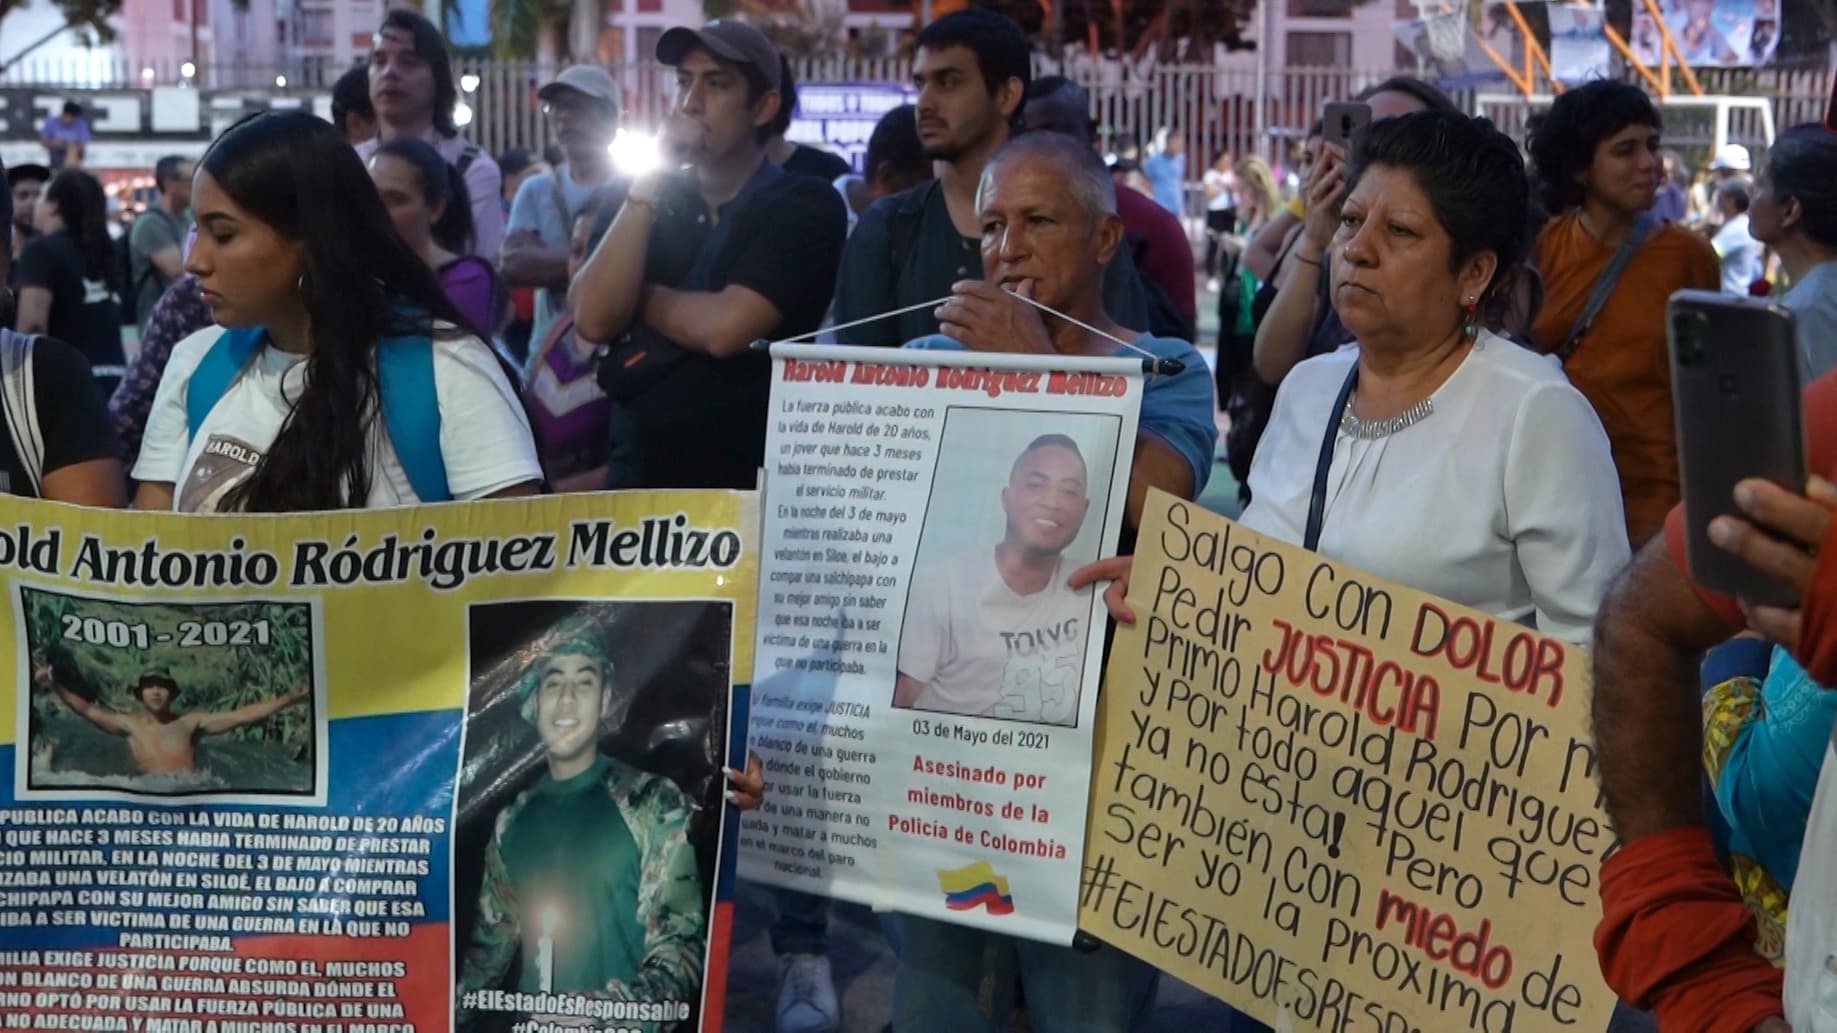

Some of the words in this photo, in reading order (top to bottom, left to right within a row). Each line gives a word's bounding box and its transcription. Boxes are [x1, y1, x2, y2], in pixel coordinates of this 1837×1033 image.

[783, 358, 847, 383] Harold
[851, 361, 929, 388] Antonio
[1046, 371, 1127, 397] Mellizo
[875, 405, 911, 418] acabo
[913, 408, 934, 419] con
[884, 424, 898, 437] 20
[820, 446, 840, 457] que
[843, 443, 870, 456] hace
[885, 447, 922, 460] meses
[803, 463, 857, 478] terminado
[876, 468, 919, 482] prestar
[806, 486, 846, 498] servicio
[875, 510, 907, 526] mayo
[70, 537, 278, 587] Antonio
[290, 528, 555, 589] Ródriguez
[567, 515, 741, 568] Mellizo
[876, 575, 896, 587] con
[1161, 502, 1284, 607] Salgo
[1305, 563, 1393, 640] Con
[1410, 602, 1565, 708] DOLOR
[61, 615, 148, 648] 2001
[180, 620, 271, 647] 2021
[1153, 566, 1251, 653] Pedir
[1262, 617, 1440, 741] JUSTICIA
[1459, 691, 1549, 777] Por
[1145, 616, 1241, 699] Primo
[1251, 664, 1395, 774] Harold
[824, 702, 870, 719] JUSTICIA
[821, 724, 864, 741] muchos
[913, 720, 929, 735] 03
[934, 722, 950, 738] de
[954, 724, 988, 746] Mayo
[992, 728, 1013, 746] del
[1017, 732, 1050, 749] 2021
[836, 748, 876, 764] guerra
[818, 768, 871, 785] gobierno
[913, 755, 1006, 785] Asesinado
[1013, 773, 1047, 790] por
[823, 784, 861, 804] fuerza
[1140, 666, 1161, 707] y
[1167, 679, 1228, 733] Por
[1236, 704, 1317, 782] todo
[1332, 766, 1464, 852] aquel
[1487, 837, 1591, 906] que
[806, 807, 852, 823] manera
[908, 786, 994, 816] miembros
[1001, 801, 1024, 820] de
[1032, 803, 1049, 823] la
[0, 809, 78, 825] PUBLICA
[81, 809, 144, 825] ACABO
[148, 812, 185, 827] CON
[189, 812, 209, 827] LA
[214, 812, 254, 828] VIDA
[258, 813, 280, 829] DE
[283, 815, 350, 831] HAROLD
[353, 816, 374, 832] DE
[376, 817, 398, 833] 20
[400, 815, 445, 833] AÑOS
[1186, 737, 1231, 785] no
[1240, 762, 1346, 859] esta!
[1386, 830, 1483, 909] Pero
[6, 830, 41, 847] QUE
[46, 830, 93, 845] HACE
[97, 830, 109, 845] 3
[114, 830, 173, 846] MESES
[177, 832, 230, 848] HABIA
[235, 834, 332, 852] TERMINADO
[335, 837, 357, 852] DE
[360, 837, 430, 854] PRESTAR
[831, 832, 877, 848] muchos
[954, 826, 974, 844] de
[980, 830, 1066, 860] Colombia
[30, 851, 107, 866] MILITAR,
[112, 851, 134, 865] EN
[138, 852, 158, 866] LA
[162, 852, 220, 868] NOCHE
[224, 853, 253, 869] DEL
[257, 855, 268, 870] 3
[272, 855, 297, 871] DE
[297, 857, 341, 873] MAYO
[345, 859, 429, 875] MIENTRAS
[55, 870, 92, 885] UNA
[96, 869, 171, 887] VELATÓN
[176, 873, 197, 887] EN
[255, 876, 272, 890] EL
[275, 877, 315, 893] BAJO
[333, 879, 417, 895] COMPRAR
[1114, 742, 1272, 875] también
[1283, 846, 1361, 917] Con
[1375, 889, 1513, 990] miedo
[1522, 953, 1581, 1025] de
[78, 890, 115, 905] CON
[119, 892, 143, 907] SU
[147, 892, 204, 909] MEJOR
[208, 895, 263, 911] AMIGO
[266, 897, 293, 912] SIN
[297, 899, 350, 915] SABER
[354, 900, 387, 917] QUE
[391, 902, 425, 916] ESA
[36, 911, 48, 925] A
[52, 911, 86, 926] SER
[91, 912, 166, 928] VICTIMA
[170, 914, 192, 929] DE
[195, 916, 229, 931] UNA
[232, 917, 295, 933] GUERRA
[299, 919, 320, 935] EN
[323, 920, 343, 935] LA
[346, 922, 381, 938] QUE
[385, 922, 410, 938] NO
[1104, 802, 1185, 867] Ser
[1195, 849, 1241, 897] yo
[1263, 876, 1301, 937] la
[1322, 917, 1516, 1033] Proxima
[44, 951, 93, 967] EXIGE
[97, 953, 175, 971] JUSTICIA
[179, 956, 241, 972] PORQUE
[246, 959, 297, 975] COMO
[326, 961, 406, 977] MUCHOS
[22, 972, 92, 988] BLANCO
[96, 974, 119, 989] DE
[122, 975, 157, 990] UNA
[162, 976, 225, 992] GUERRA
[228, 978, 310, 997] ABSURDA
[314, 979, 373, 998] DÓNDE
[378, 982, 396, 997] EL
[36, 991, 82, 1009] OPTÓ
[86, 994, 120, 1010] POR
[125, 996, 171, 1012] USAR
[174, 998, 193, 1013] LA
[197, 999, 258, 1016] FUERZA
[262, 999, 337, 1018] PÚBLICA
[341, 1003, 363, 1017] DE
[367, 1003, 404, 1018] UNA
[462, 990, 690, 1021] #ElEstadoEsResponsable
[7, 1013, 31, 1028] NO
[34, 1014, 127, 1031] ADECUADA
[131, 1016, 143, 1031] Y
[146, 1018, 202, 1033] MATAR
[206, 1019, 217, 1033] A
[221, 1021, 297, 1033] MUCHOS
